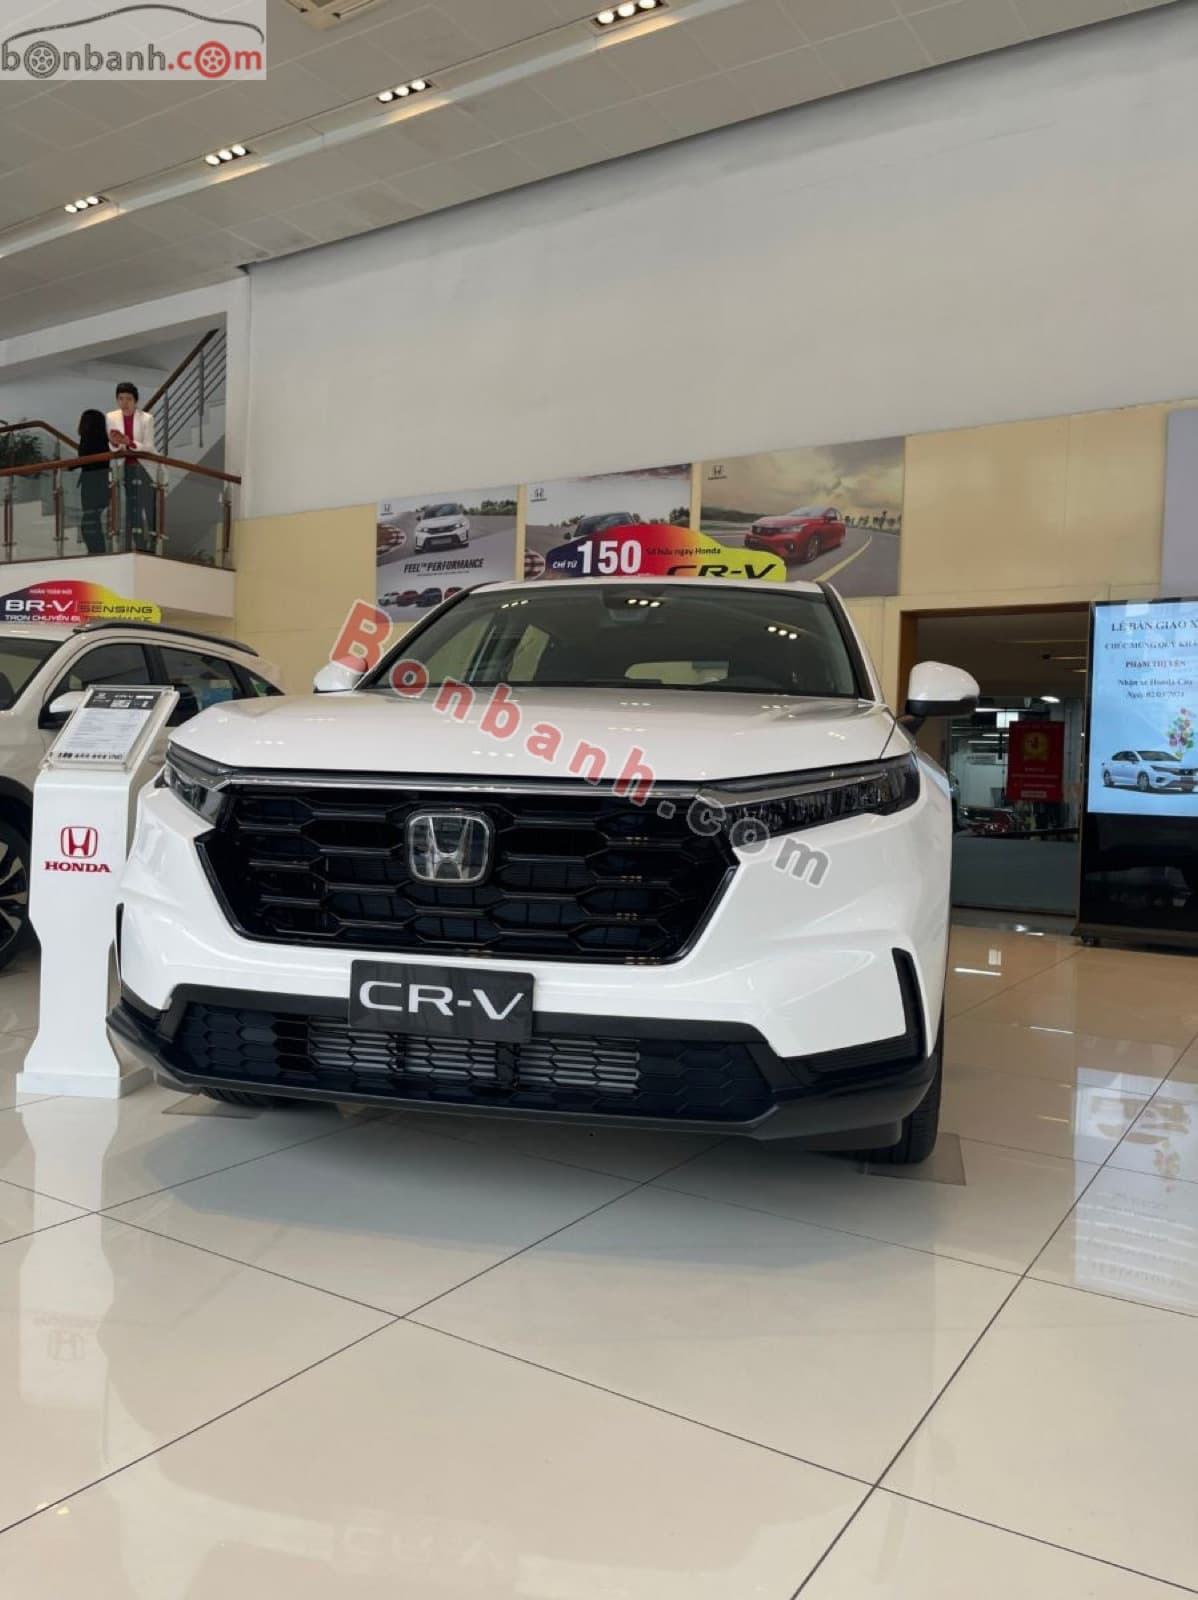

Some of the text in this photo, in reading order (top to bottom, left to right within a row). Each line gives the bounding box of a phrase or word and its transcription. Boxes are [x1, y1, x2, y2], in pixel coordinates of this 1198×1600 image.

[577, 540, 642, 574] 150
[695, 547, 721, 555] Honda
[404, 563, 421, 573] FEEL
[427, 558, 485, 571] PERFORMANCE
[666, 564, 777, 579] CR-V
[5, 600, 153, 613] BR-V SENSING
[1155, 620, 1186, 630] GIAO
[44, 861, 112, 873] HONDA
[360, 980, 525, 1021] CR-V
